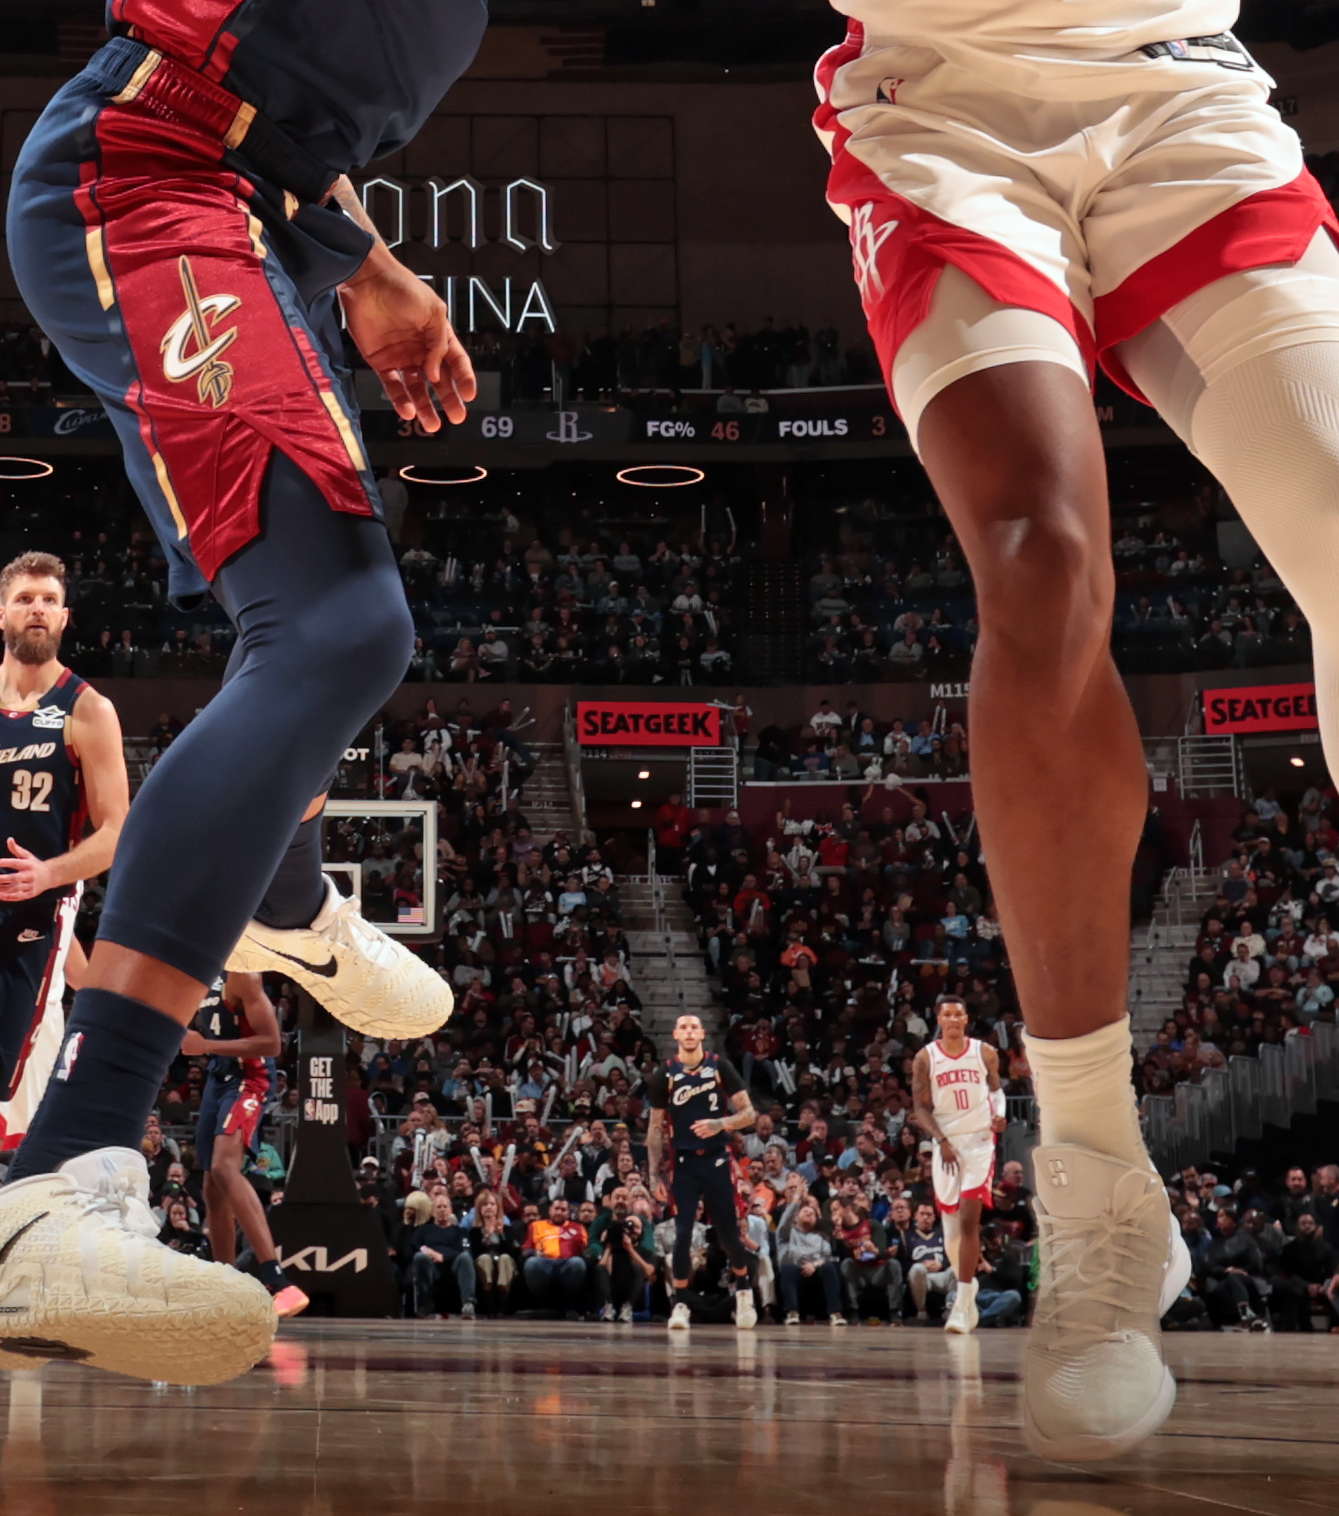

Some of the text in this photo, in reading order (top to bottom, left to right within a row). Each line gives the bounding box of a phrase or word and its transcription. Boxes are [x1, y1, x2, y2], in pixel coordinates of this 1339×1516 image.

[481, 416, 514, 438] 69
[646, 420, 740, 441] FG% 46
[779, 417, 886, 438] FOULS 3
[34, 719, 63, 727] CLIFFS
[583, 710, 712, 738] SEATGEEK
[11, 769, 53, 812] 32
[210, 1013, 221, 1036] 4
[310, 1057, 333, 1078] GET
[310, 1078, 333, 1099] THE
[936, 1069, 980, 1088] ROCKETS
[709, 1093, 719, 1111] 2
[954, 1089, 969, 1110] 10
[315, 1100, 338, 1124] App
